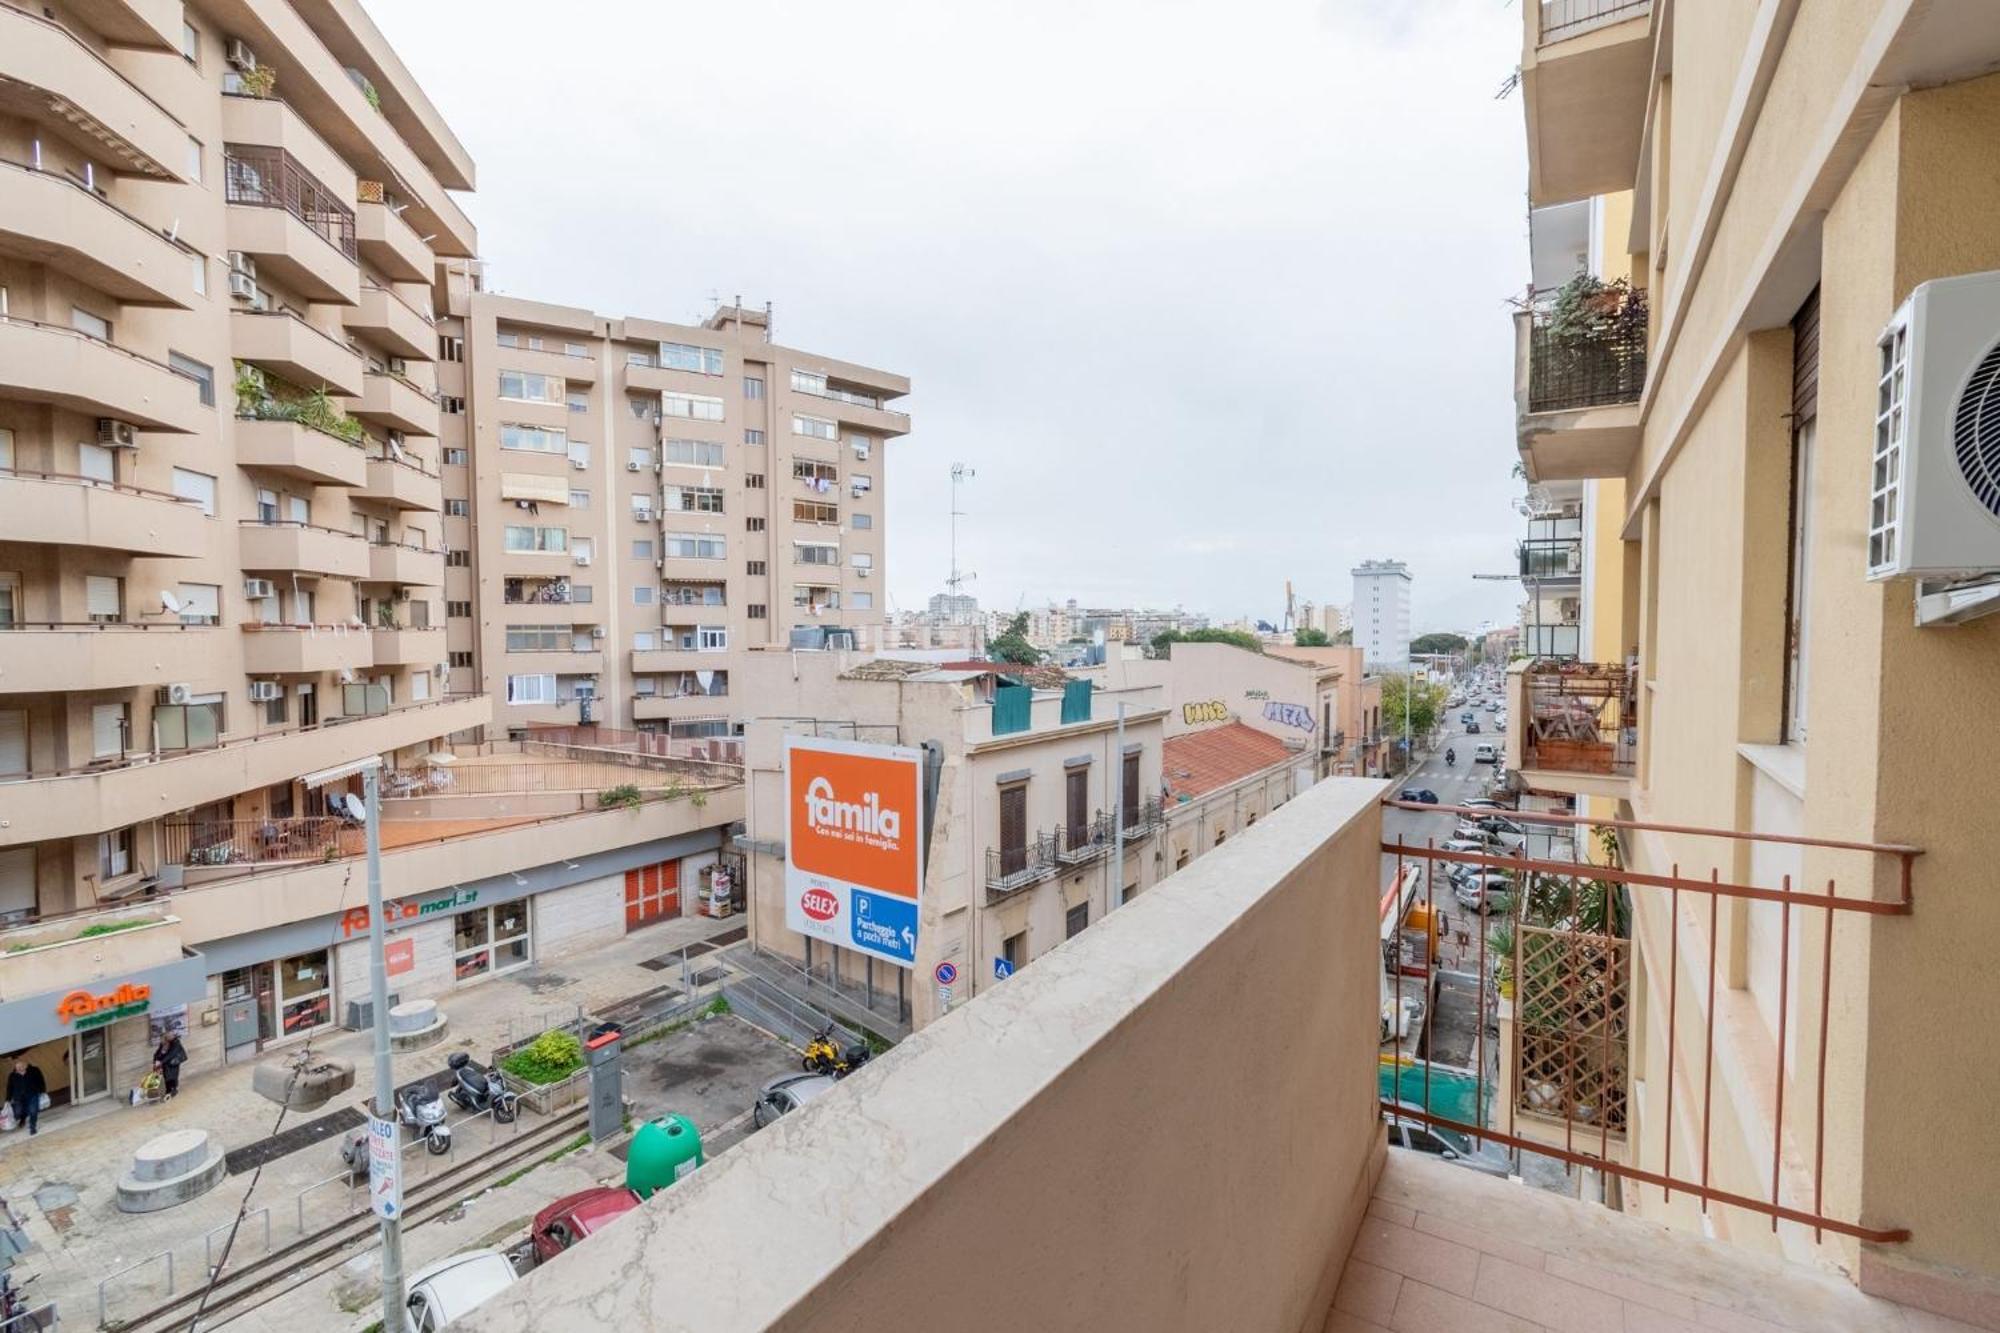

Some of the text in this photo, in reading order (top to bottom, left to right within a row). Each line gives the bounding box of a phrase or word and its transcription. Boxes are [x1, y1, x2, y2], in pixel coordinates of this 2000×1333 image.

[804, 776, 900, 839] famila
[815, 825, 830, 836] Con
[803, 893, 837, 917] SELEX
[859, 898, 868, 914] P
[856, 917, 897, 939] Parcheggio
[56, 982, 151, 1025] famila
